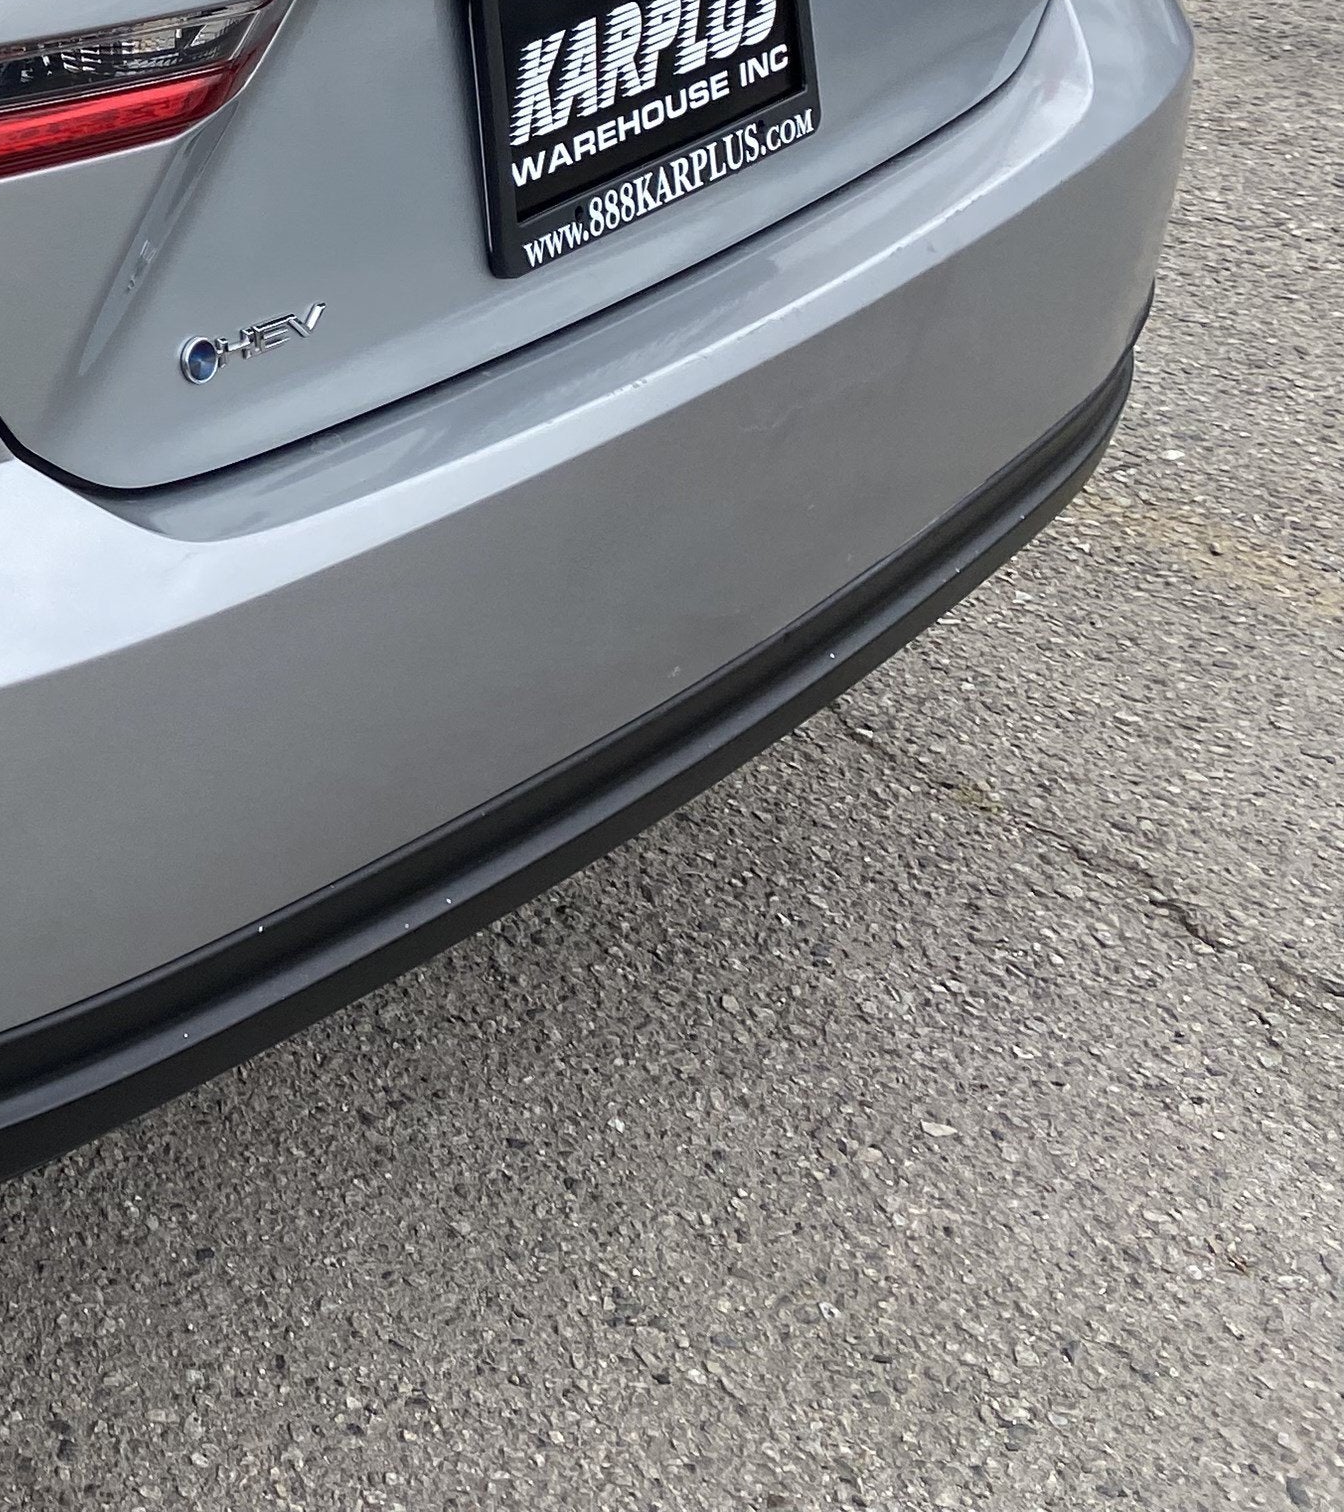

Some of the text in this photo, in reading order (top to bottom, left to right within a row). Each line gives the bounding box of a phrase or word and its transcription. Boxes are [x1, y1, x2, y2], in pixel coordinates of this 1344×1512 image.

[510, 43, 790, 188] WAREHOUSE INC
[215, 302, 327, 370] HEV
